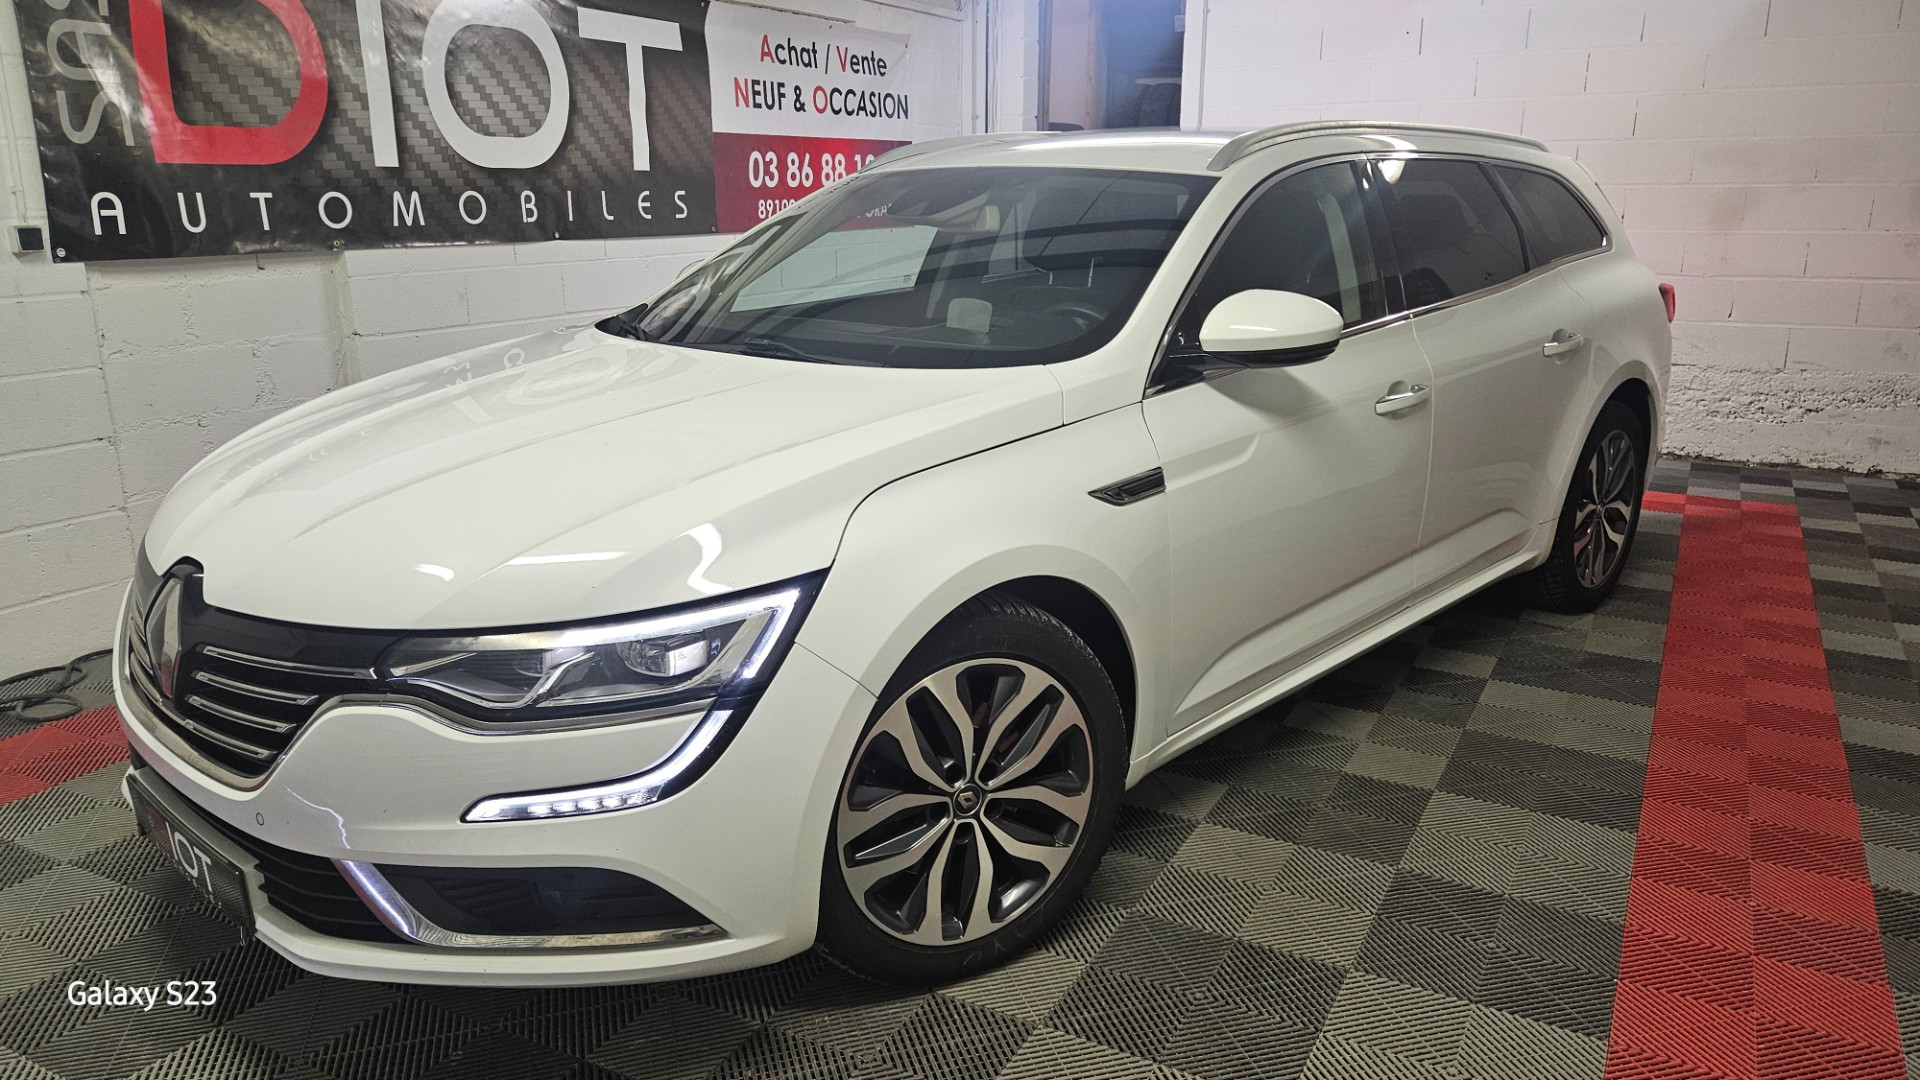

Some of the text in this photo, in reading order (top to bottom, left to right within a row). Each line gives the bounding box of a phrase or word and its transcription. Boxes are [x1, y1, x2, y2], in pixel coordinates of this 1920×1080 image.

[44, 0, 135, 146] SA
[760, 34, 888, 77] Achat / Vente
[129, 0, 683, 171] DIOT
[734, 77, 909, 119] NEUF & OCCASION
[748, 151, 876, 188] 03 86 88 1
[90, 190, 688, 235] AUTOMOBILES
